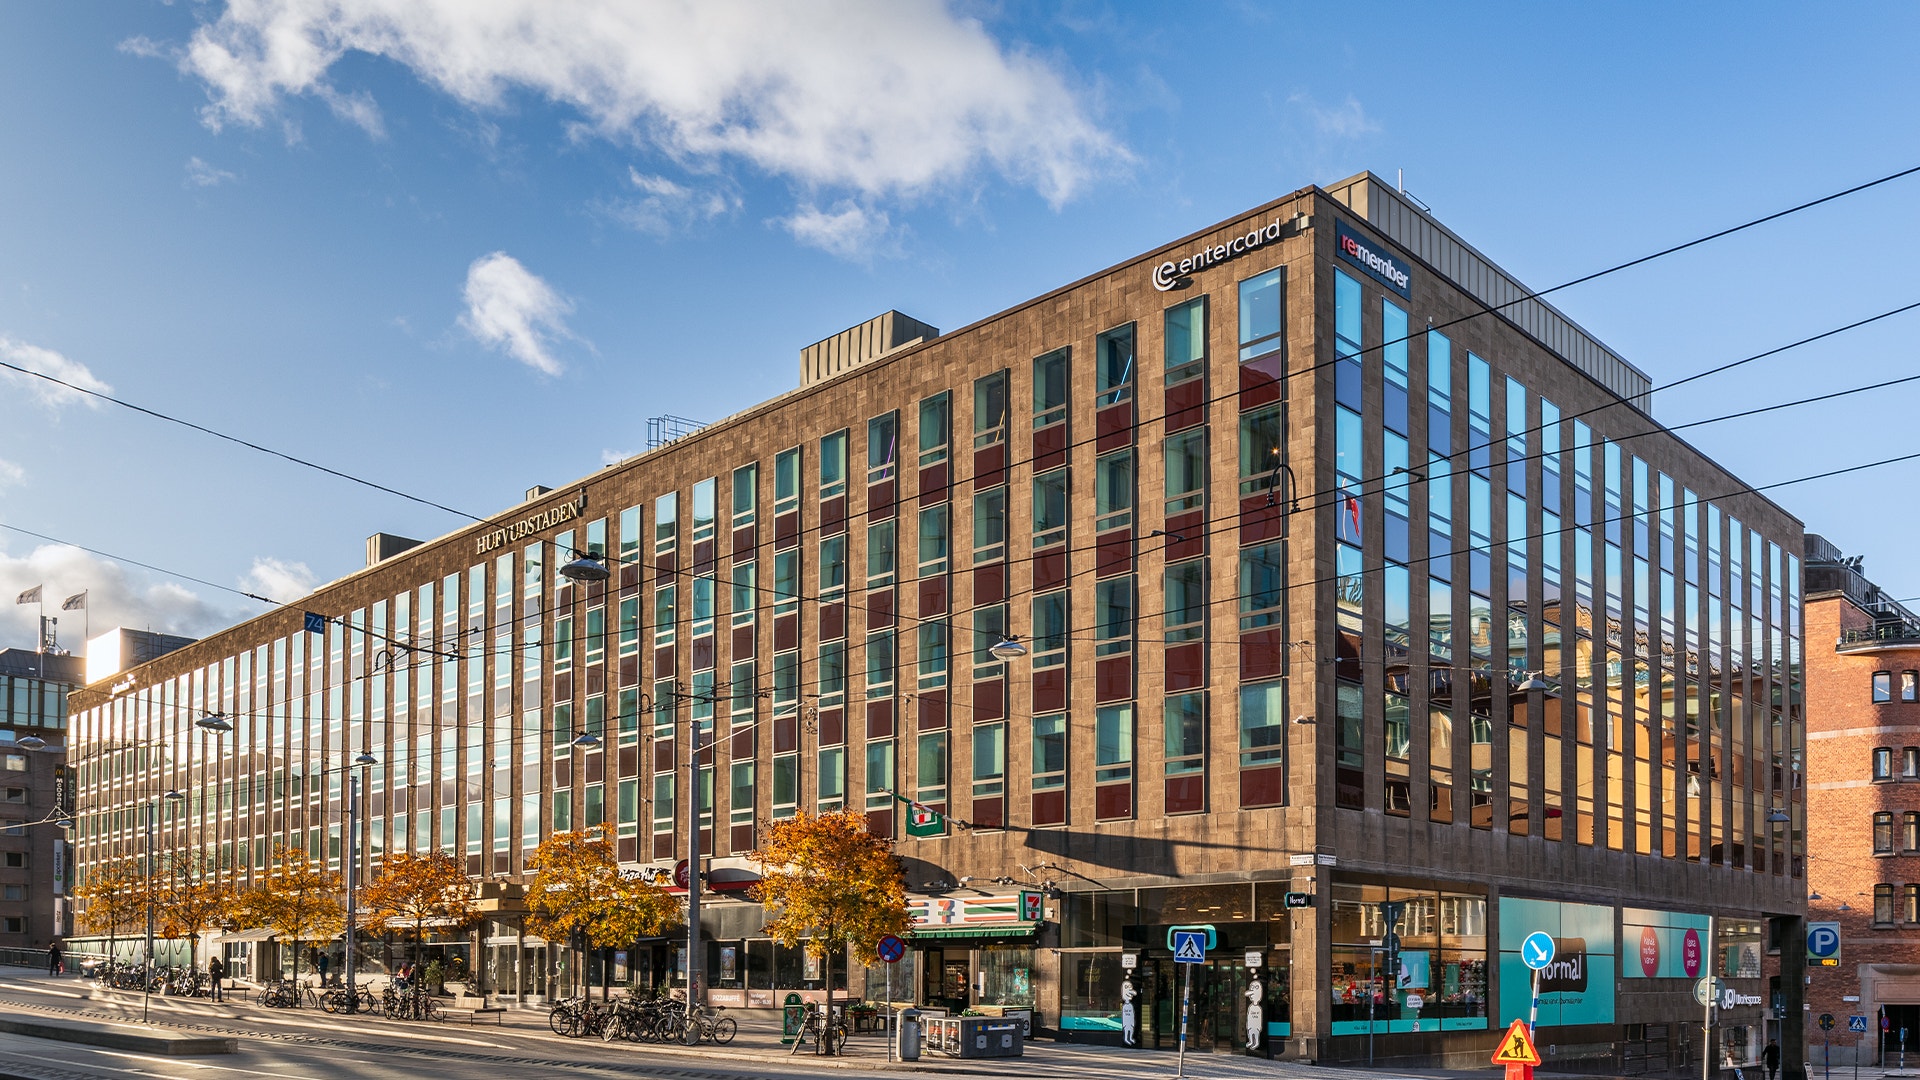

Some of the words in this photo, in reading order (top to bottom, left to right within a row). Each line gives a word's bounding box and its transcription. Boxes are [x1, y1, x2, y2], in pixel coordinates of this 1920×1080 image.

[1180, 218, 1280, 274] entercard
[1340, 234, 1409, 290] re:member
[476, 500, 578, 555] HUFVUDSTADEN
[306, 614, 324, 631] 74
[1027, 896, 1039, 918] 7
[1290, 895, 1305, 904] Normal
[938, 900, 950, 923] 7
[1815, 930, 1835, 953] P
[1736, 994, 1762, 1006] Workspace
